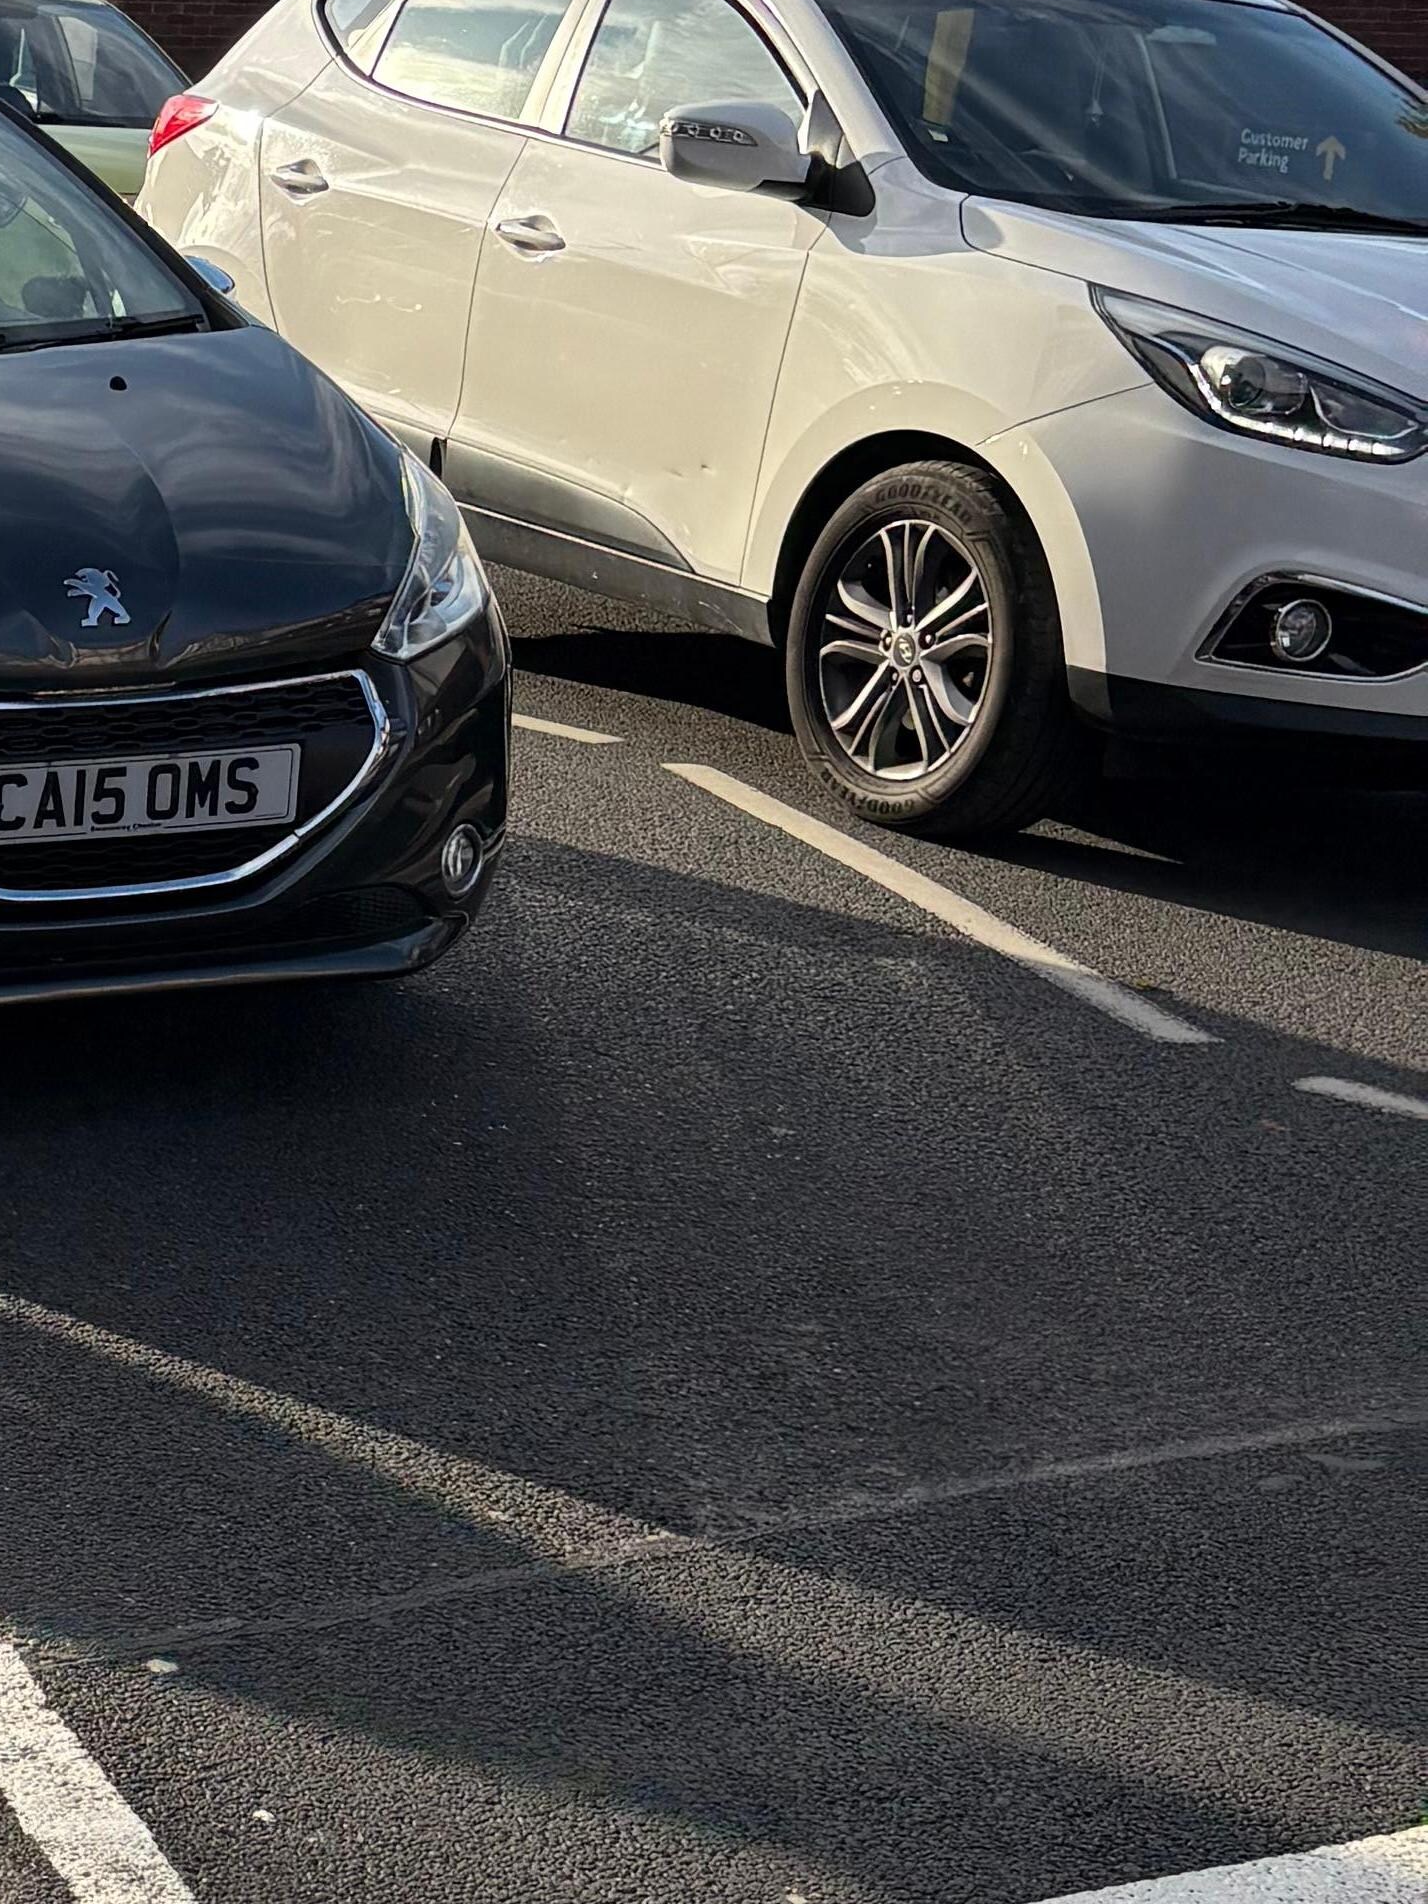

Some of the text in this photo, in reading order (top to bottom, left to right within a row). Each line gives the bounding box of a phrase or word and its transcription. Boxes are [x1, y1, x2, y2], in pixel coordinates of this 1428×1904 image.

[1240, 127, 1309, 150] Customer
[1237, 146, 1289, 174] Parking
[145, 756, 260, 821] OMS
